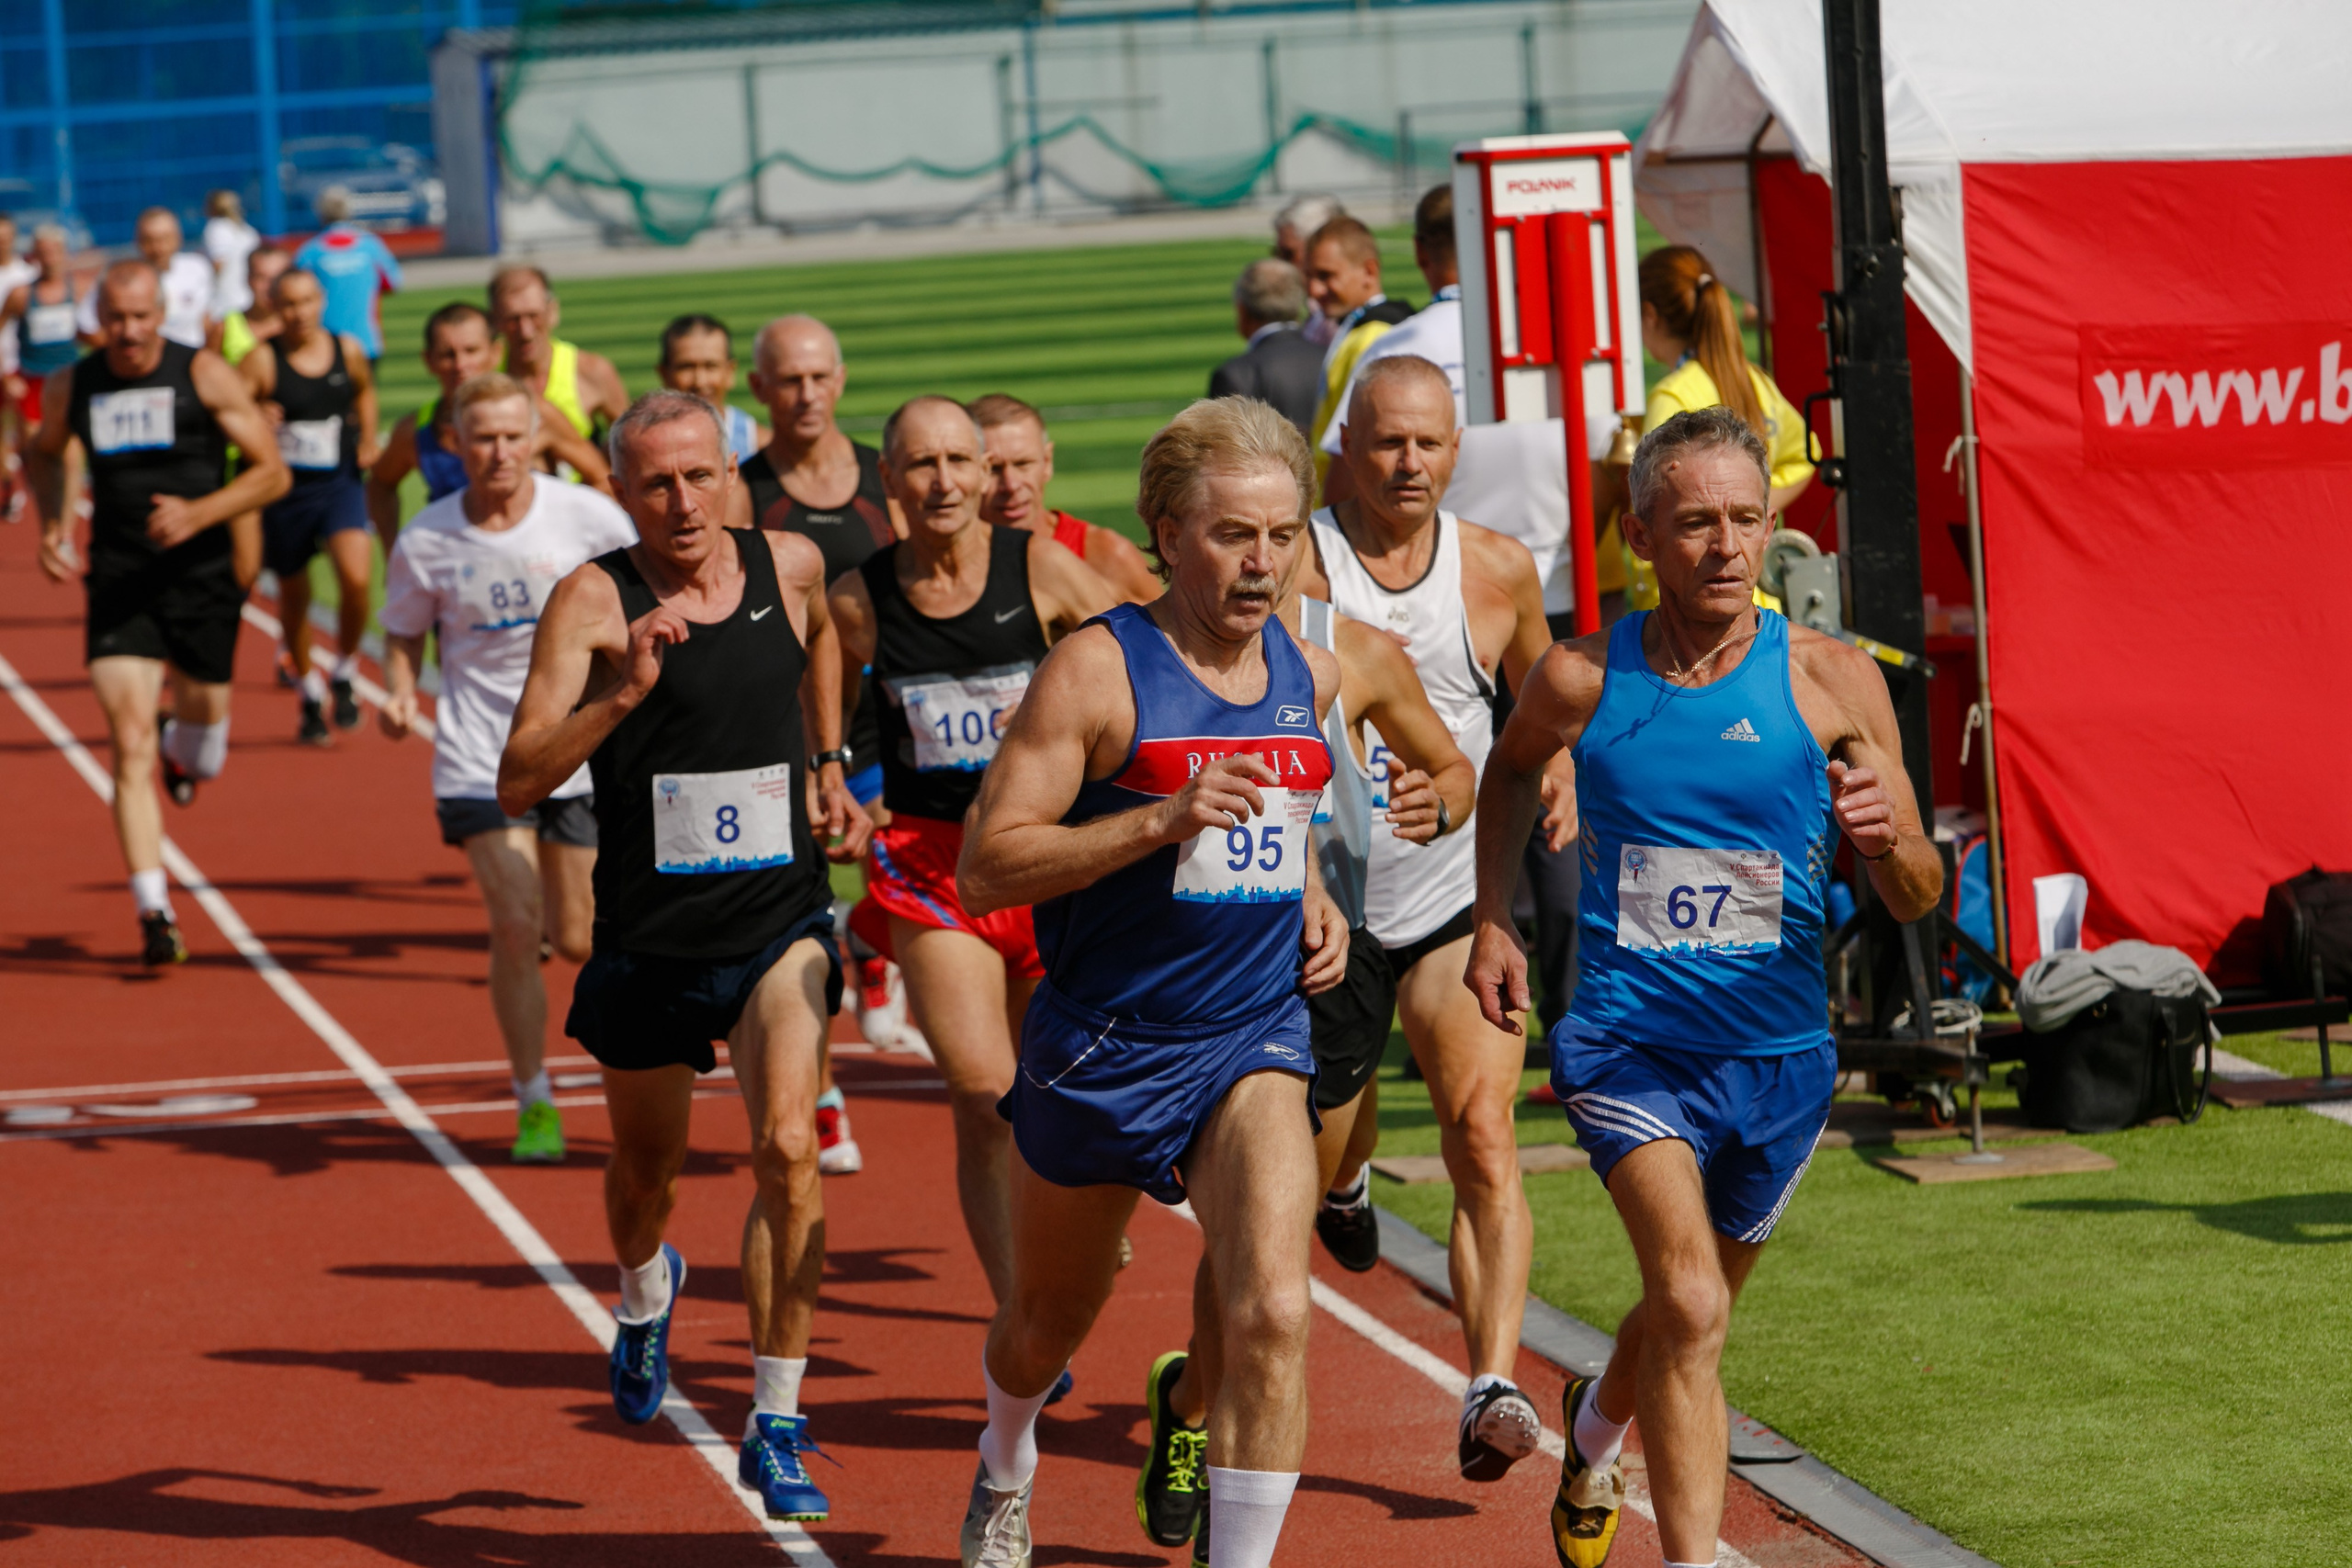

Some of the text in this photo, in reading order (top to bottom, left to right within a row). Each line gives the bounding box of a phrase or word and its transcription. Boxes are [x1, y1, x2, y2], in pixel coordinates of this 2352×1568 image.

[2093, 341, 2352, 429] www.b
[489, 579, 530, 610] 83
[1721, 730, 1760, 742] adidas
[1186, 750, 1307, 779] RIA
[716, 805, 740, 843] 8
[1227, 825, 1283, 872] 95
[1736, 863, 1780, 872] Спартакиада
[1668, 885, 1732, 930] 67
